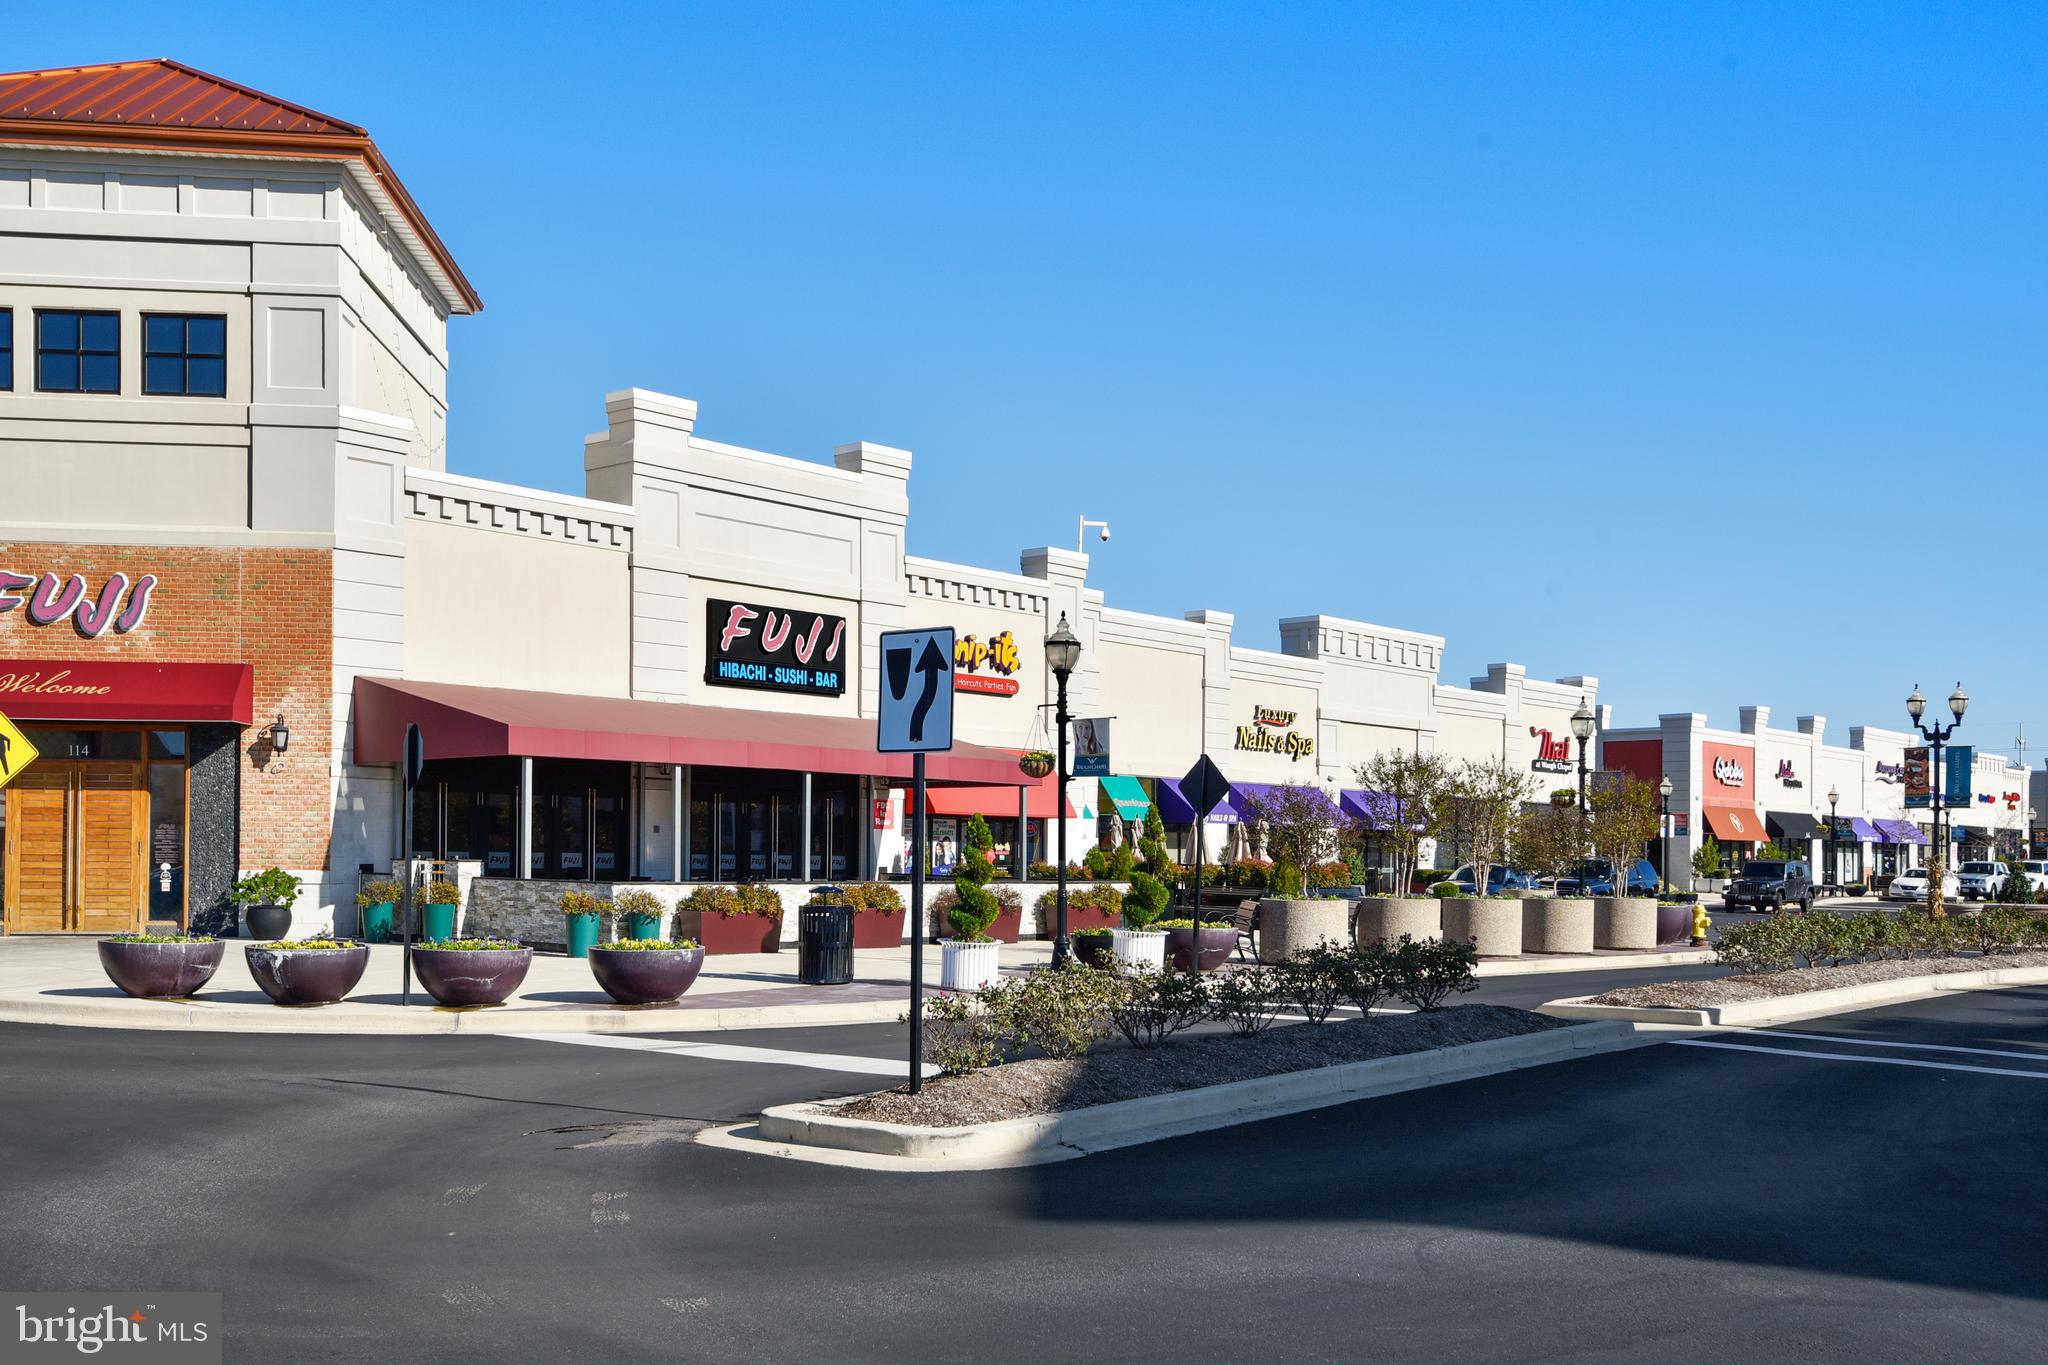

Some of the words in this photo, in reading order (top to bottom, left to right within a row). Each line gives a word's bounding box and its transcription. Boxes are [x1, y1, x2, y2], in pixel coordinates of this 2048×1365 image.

[721, 605, 845, 663] FUJI
[955, 631, 1020, 674] nip-its
[0, 670, 111, 694] Welcome
[720, 662, 766, 681] HIBACHI
[775, 667, 808, 685] SUSHI
[816, 671, 838, 688] BAR
[1255, 705, 1298, 724] Luxury
[69, 744, 89, 756] 114
[1237, 726, 1276, 751] Nails
[1276, 736, 1286, 753] &
[1287, 731, 1314, 761] Spa
[1530, 726, 1570, 761] Thai
[1714, 756, 1744, 784] Qdoba
[490, 855, 508, 865] FUJI
[563, 856, 580, 865] FUJI
